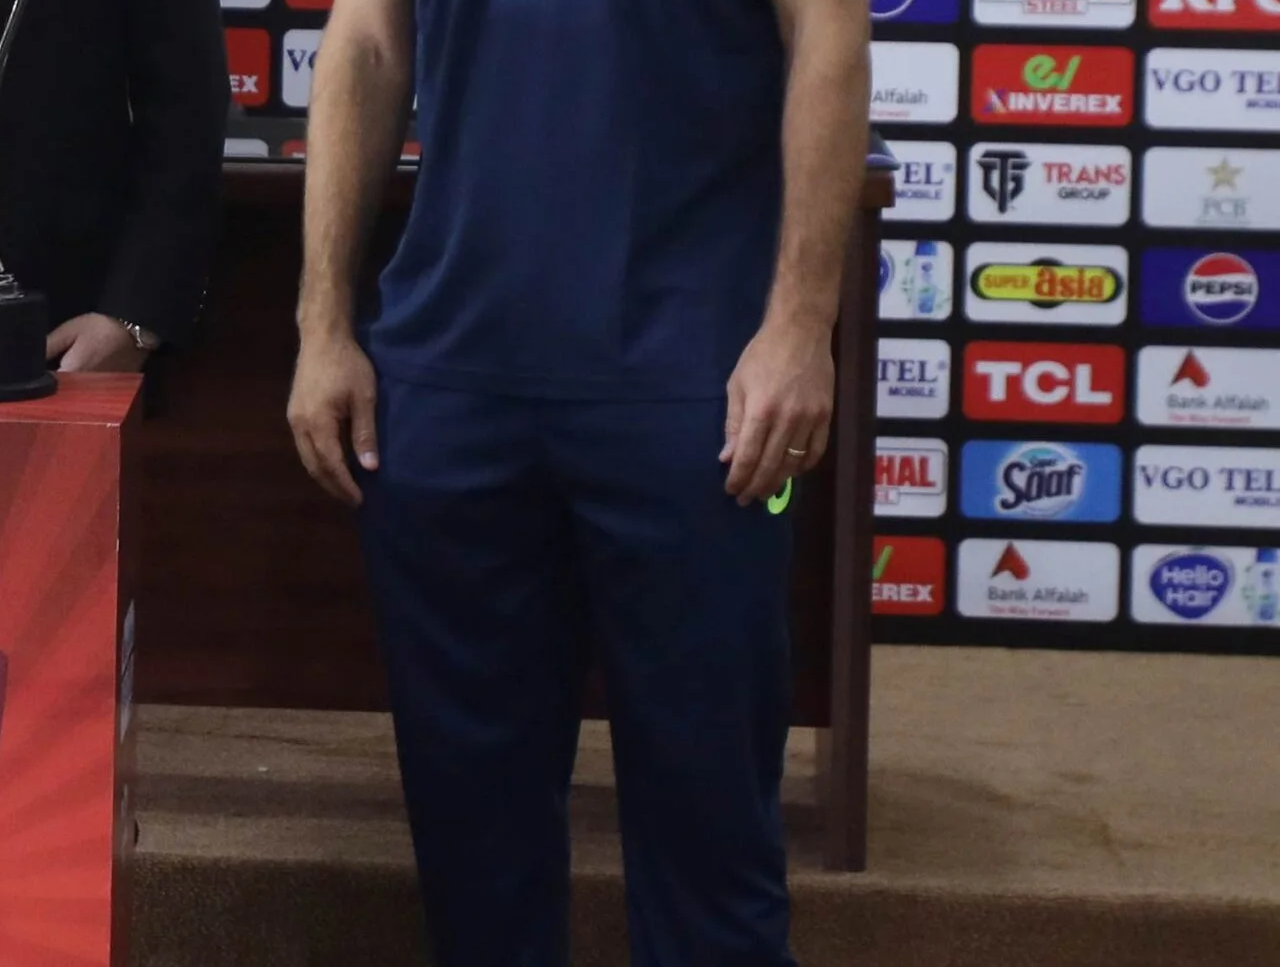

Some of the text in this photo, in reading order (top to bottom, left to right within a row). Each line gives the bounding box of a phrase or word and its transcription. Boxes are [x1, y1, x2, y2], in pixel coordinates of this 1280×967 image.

[1009, 93, 1120, 114] INVEREX
[1042, 161, 1125, 184] TRANS
[984, 268, 1104, 300] SUPER asia
[1190, 281, 1252, 296] PEPSI
[975, 360, 1112, 404] TCL
[1161, 565, 1223, 586] Hello
[1165, 588, 1218, 607] Hair
